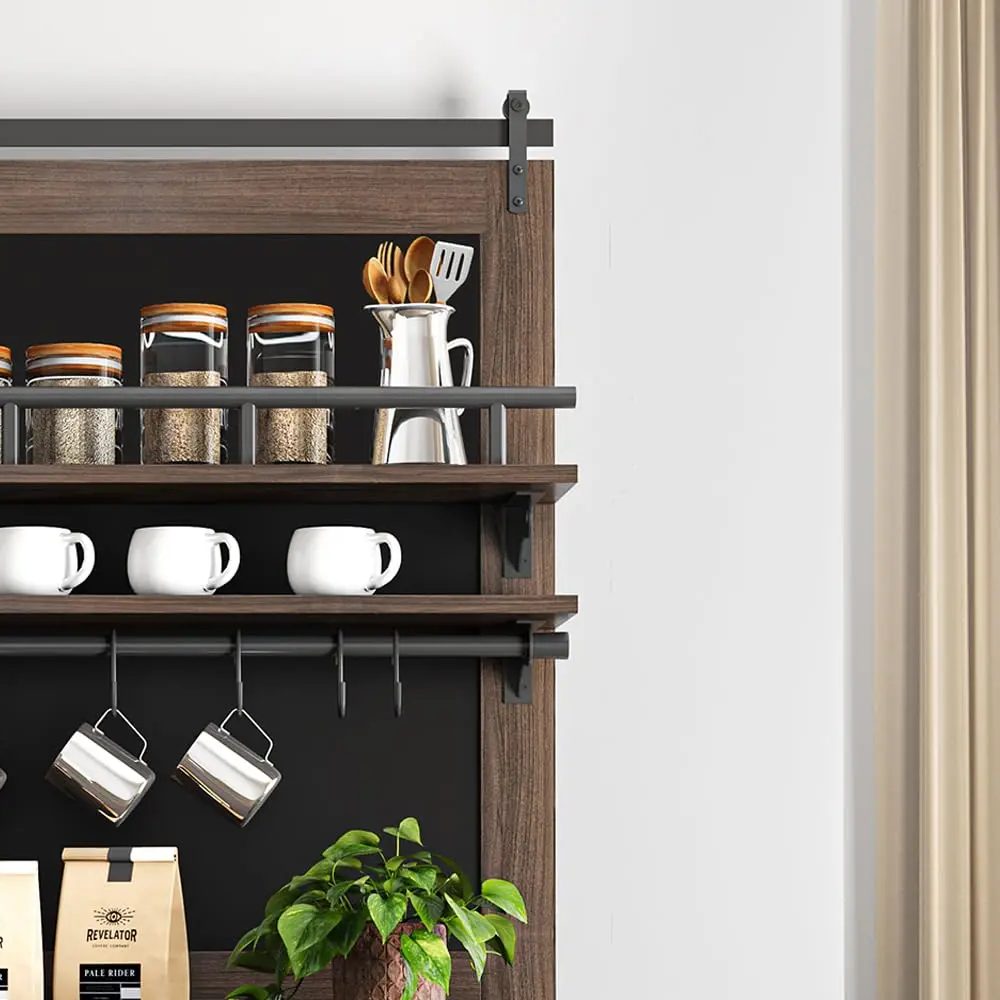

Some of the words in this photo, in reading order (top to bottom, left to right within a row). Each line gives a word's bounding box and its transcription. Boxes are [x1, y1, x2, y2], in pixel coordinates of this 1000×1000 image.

[86, 928, 138, 942] REVELATOR
[84, 969, 106, 977] PALE
[108, 969, 136, 977] RIDER
